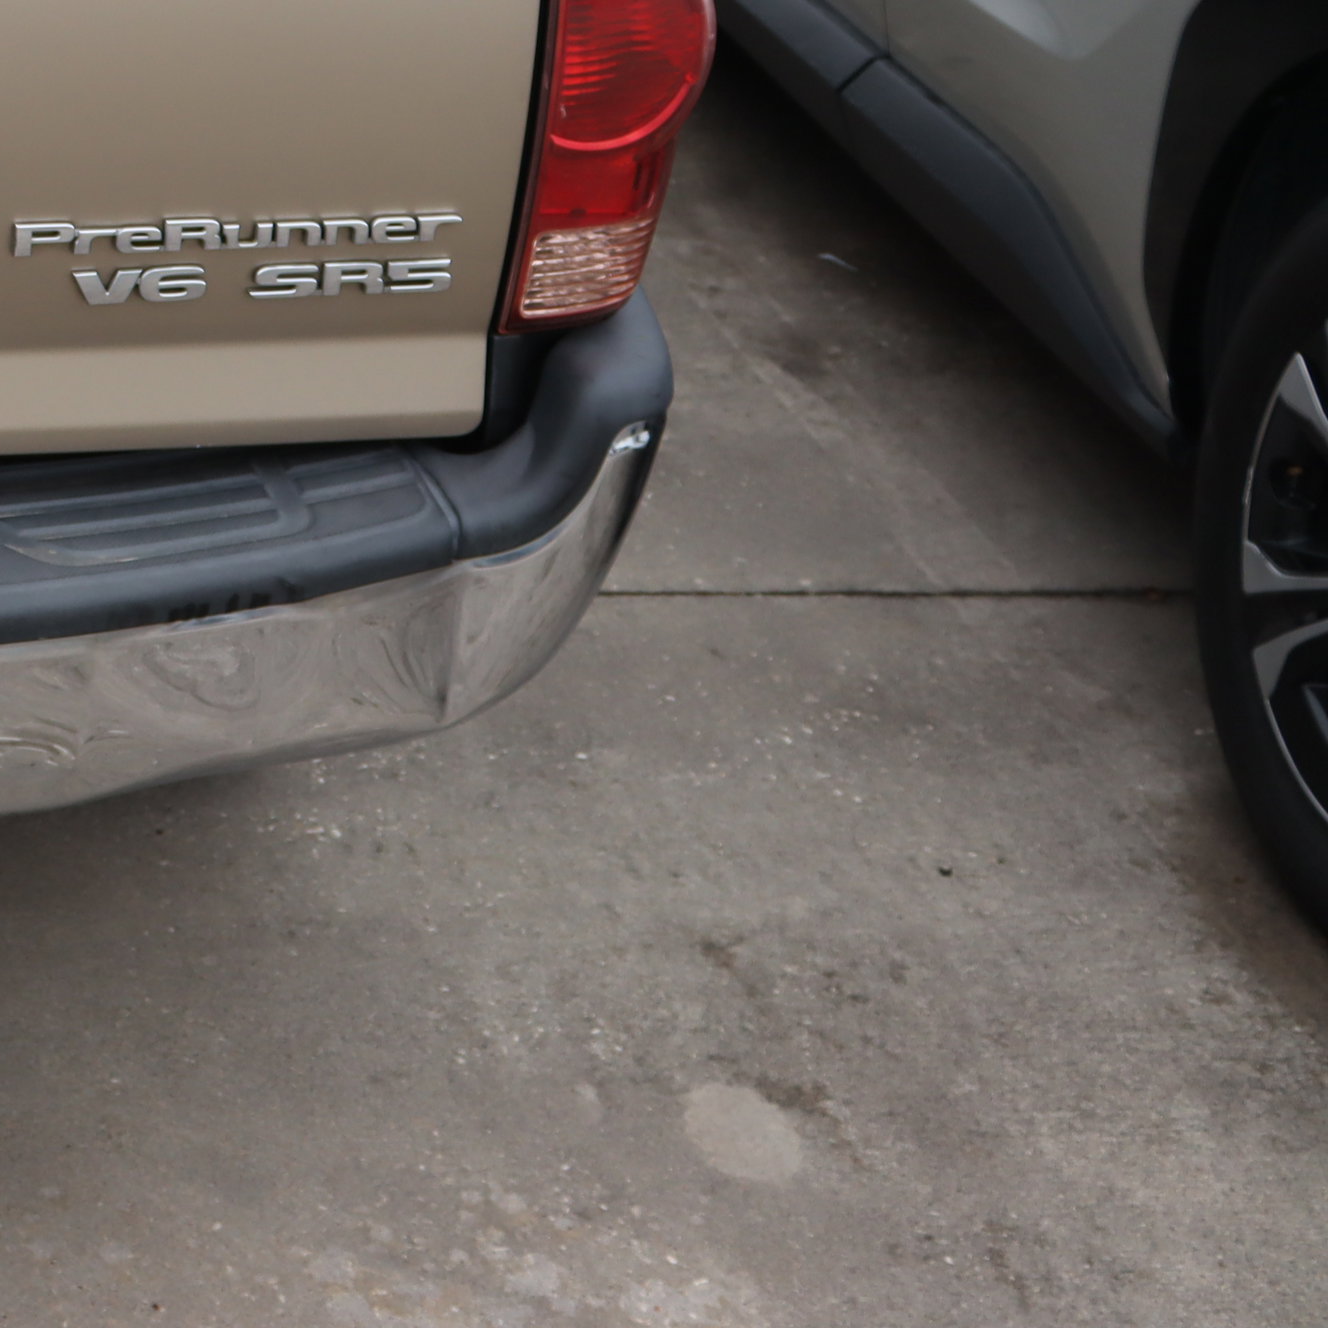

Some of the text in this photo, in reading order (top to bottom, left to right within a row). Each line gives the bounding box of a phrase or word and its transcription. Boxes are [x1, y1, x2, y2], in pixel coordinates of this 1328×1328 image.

[13, 214, 463, 257] PreRunner
[72, 258, 452, 305] V6 SR5
